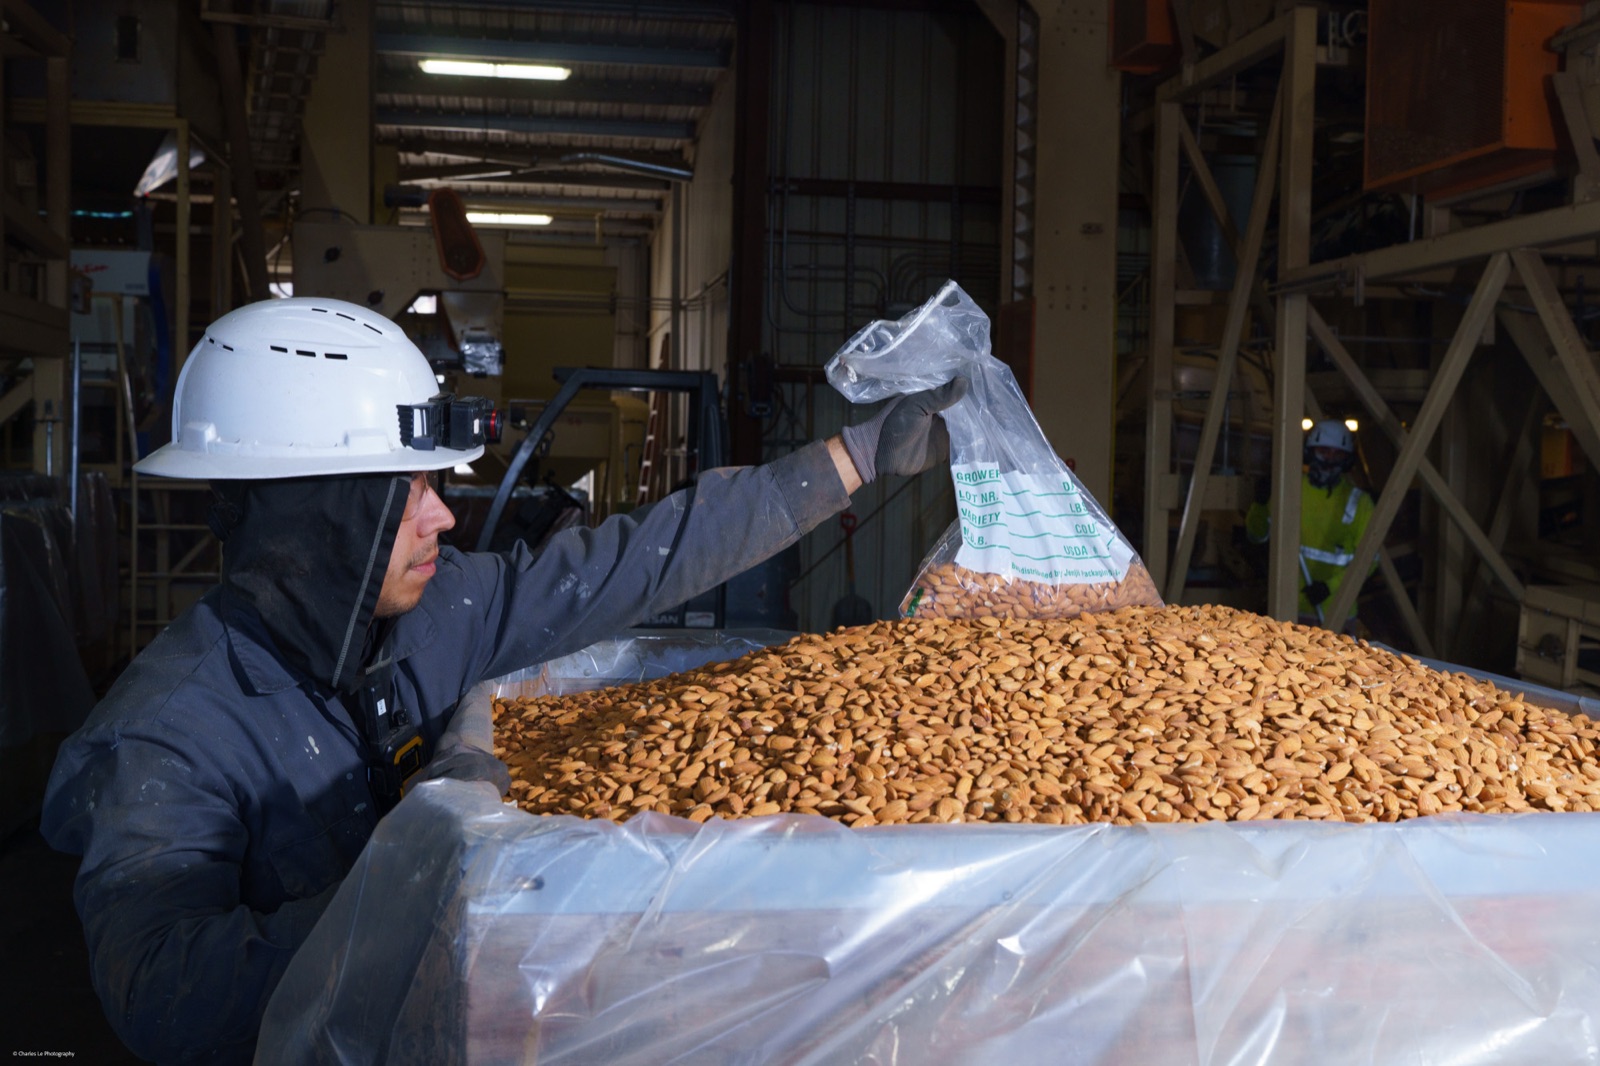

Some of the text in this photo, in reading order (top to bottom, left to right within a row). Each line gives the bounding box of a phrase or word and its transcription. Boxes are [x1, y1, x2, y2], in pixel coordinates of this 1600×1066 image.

[959, 490, 999, 504] LOT NR.
[961, 508, 1001, 525] VARIETY
[1074, 522, 1097, 534] COU
[1063, 545, 1089, 557] USDA
